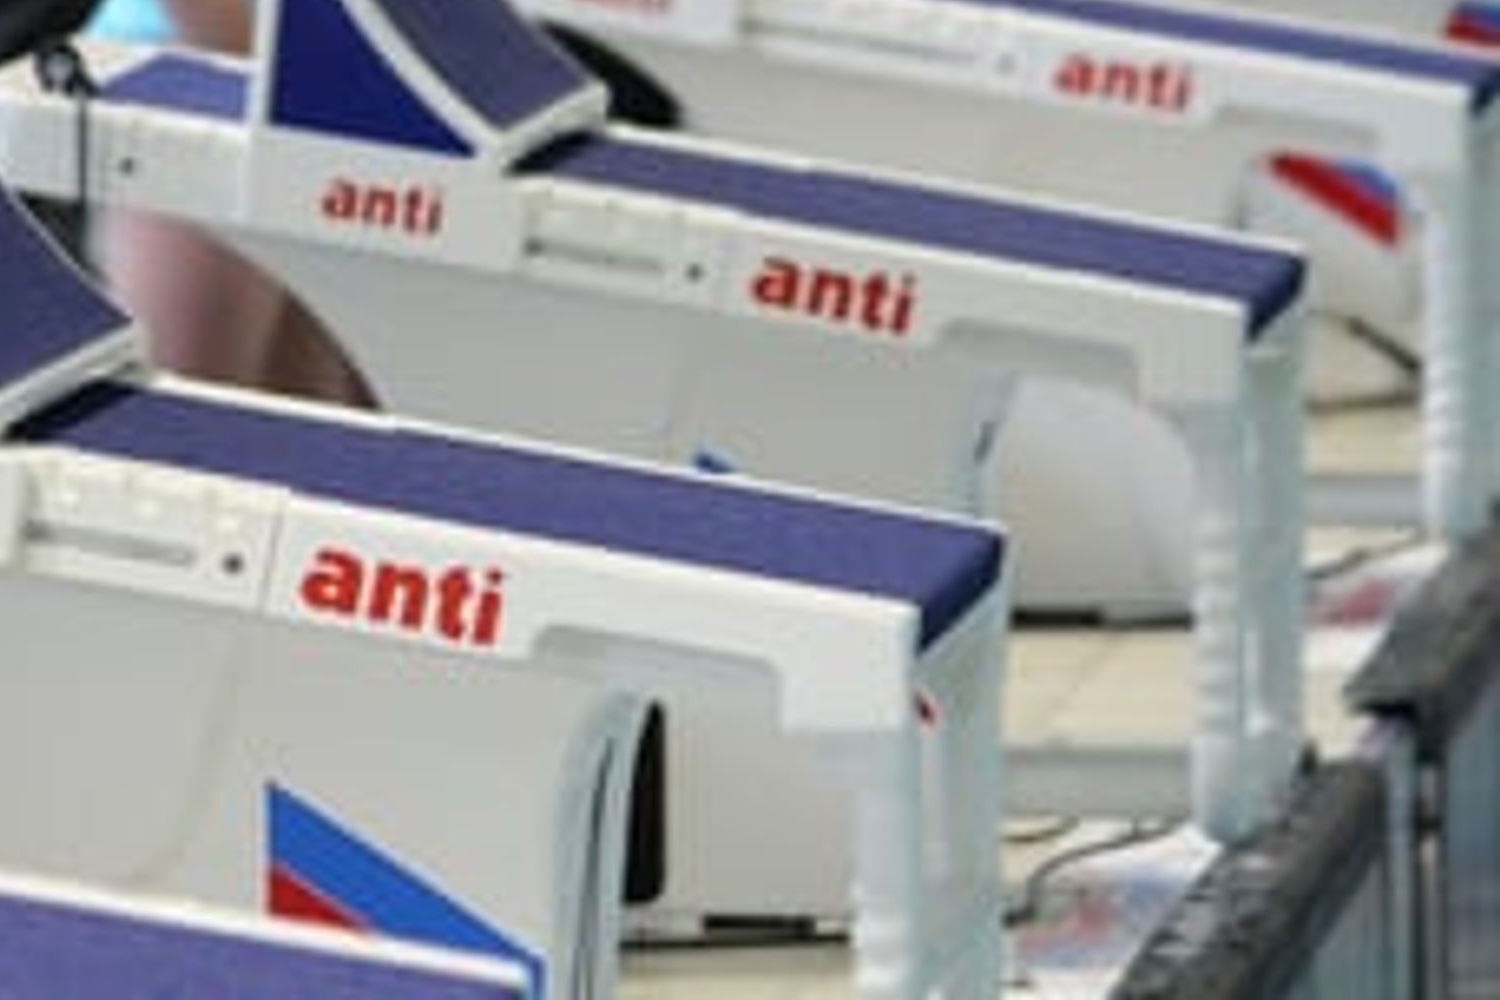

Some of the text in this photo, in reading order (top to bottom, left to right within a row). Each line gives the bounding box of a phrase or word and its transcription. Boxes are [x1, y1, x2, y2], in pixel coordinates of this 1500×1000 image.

[1053, 52, 1193, 113] anti
[322, 177, 444, 237] anti
[752, 255, 917, 336] anti
[301, 548, 505, 646] anti
